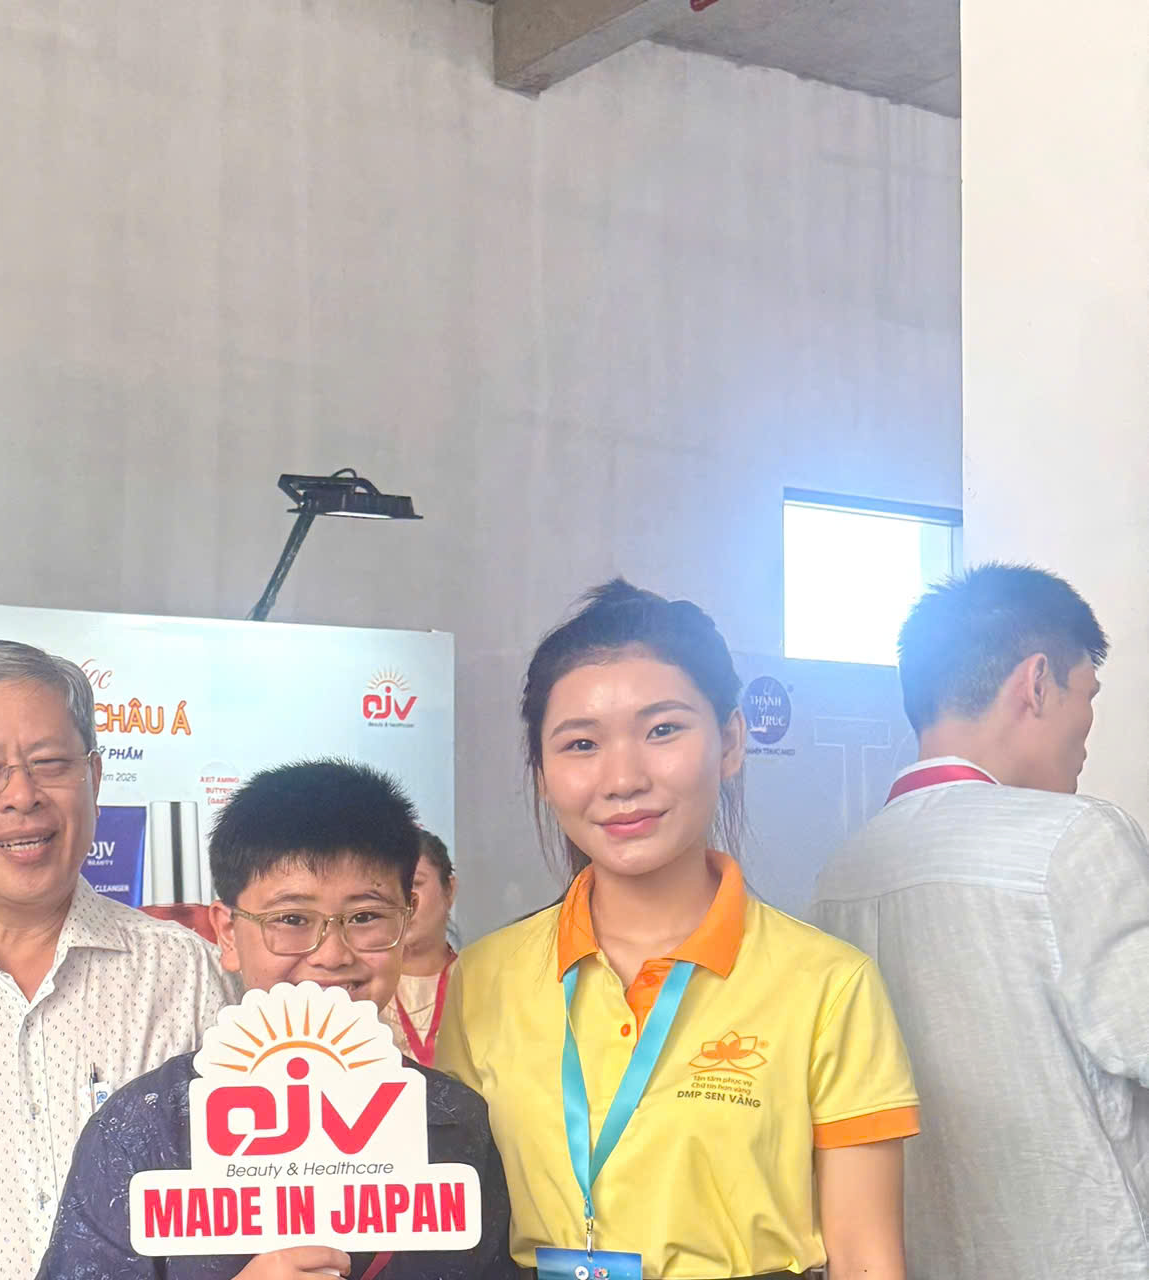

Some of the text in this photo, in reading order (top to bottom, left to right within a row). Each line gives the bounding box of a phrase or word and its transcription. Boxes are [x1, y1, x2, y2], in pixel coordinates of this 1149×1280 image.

[94, 698, 191, 735] CHÂU Á
[94, 884, 130, 893] CLEANSER
[677, 1090, 761, 1108] DMP SEN VÀNG
[226, 1161, 394, 1179] Beauty & Healthcare
[143, 1182, 467, 1238] MADE IN JAPAN
